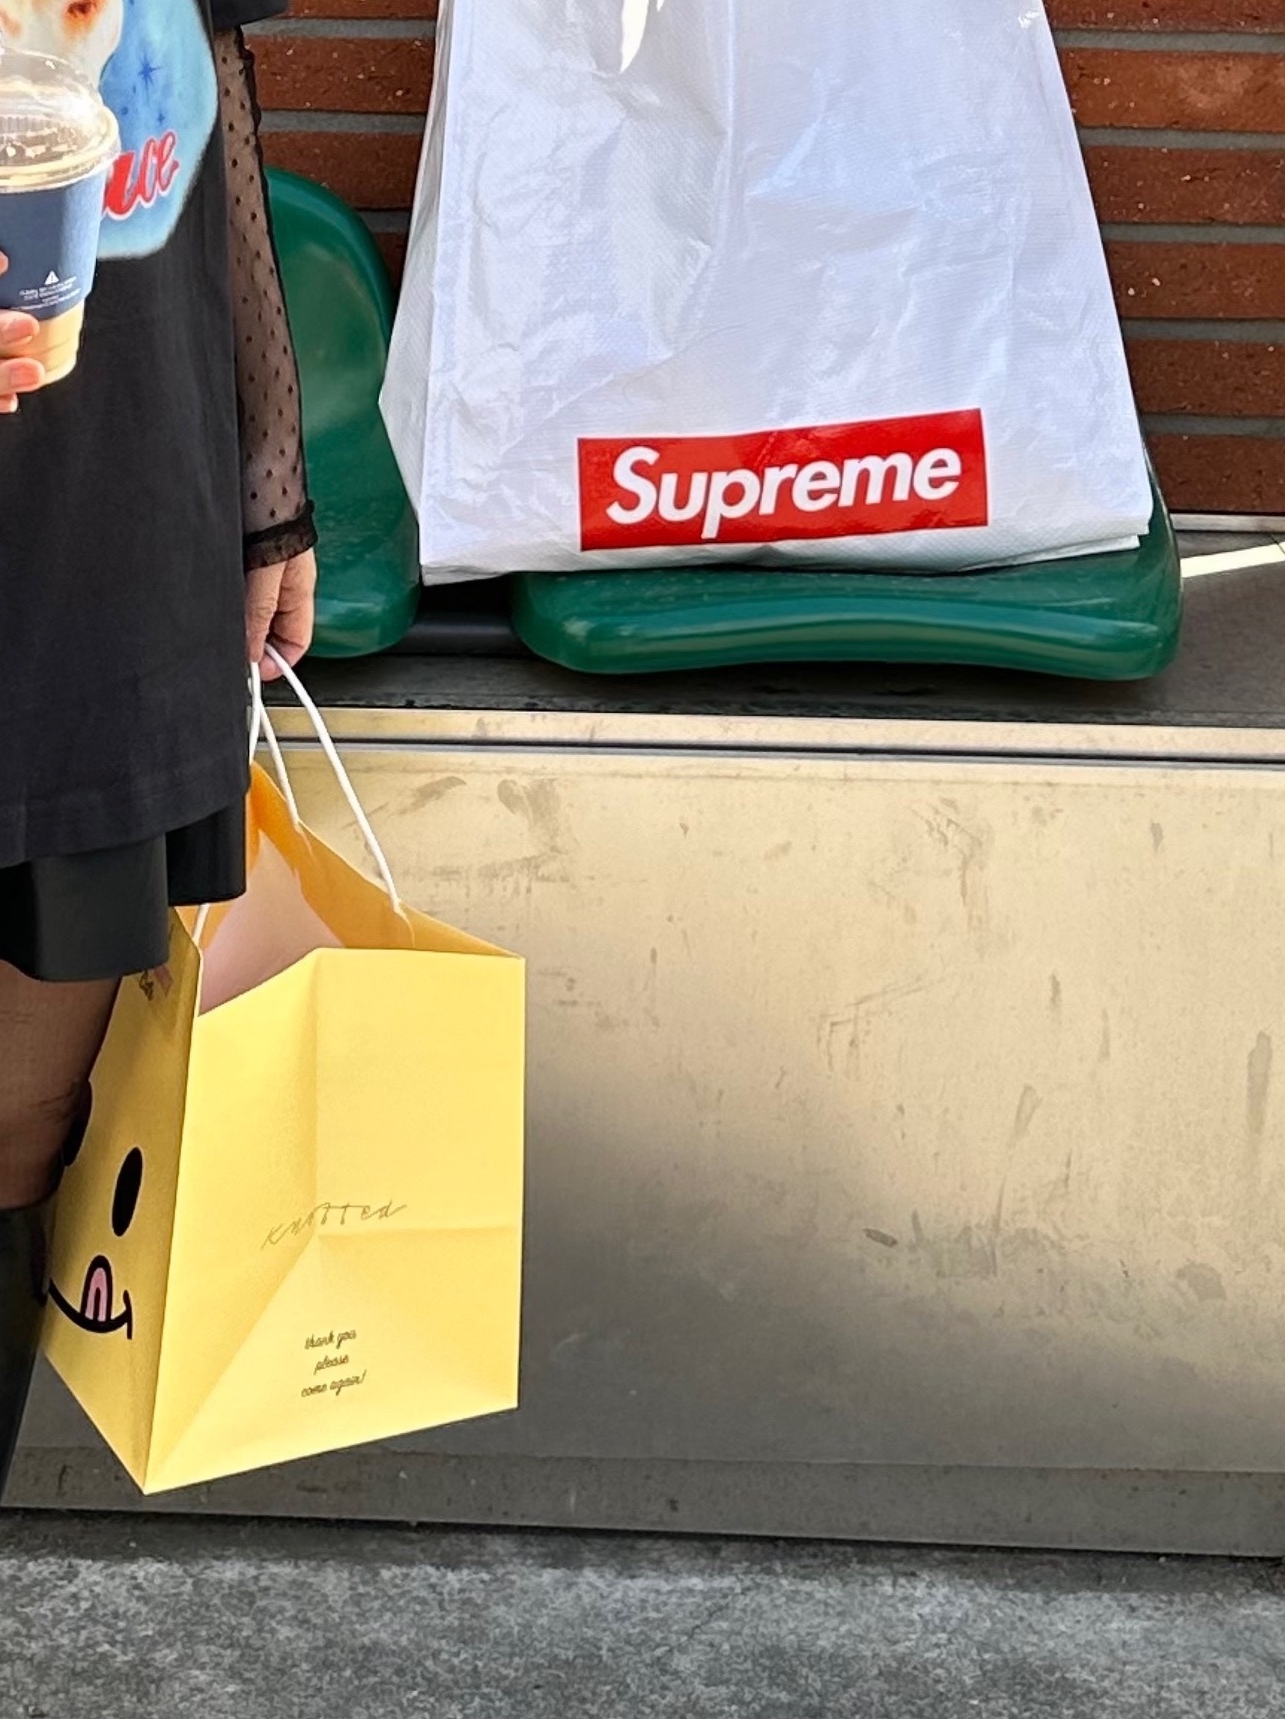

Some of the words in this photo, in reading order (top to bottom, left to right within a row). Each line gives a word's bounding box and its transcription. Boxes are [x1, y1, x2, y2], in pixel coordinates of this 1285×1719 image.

[606, 445, 962, 540] Supreme
[305, 1331, 334, 1350] thank
[336, 1330, 357, 1350] you
[313, 1354, 350, 1375] please
